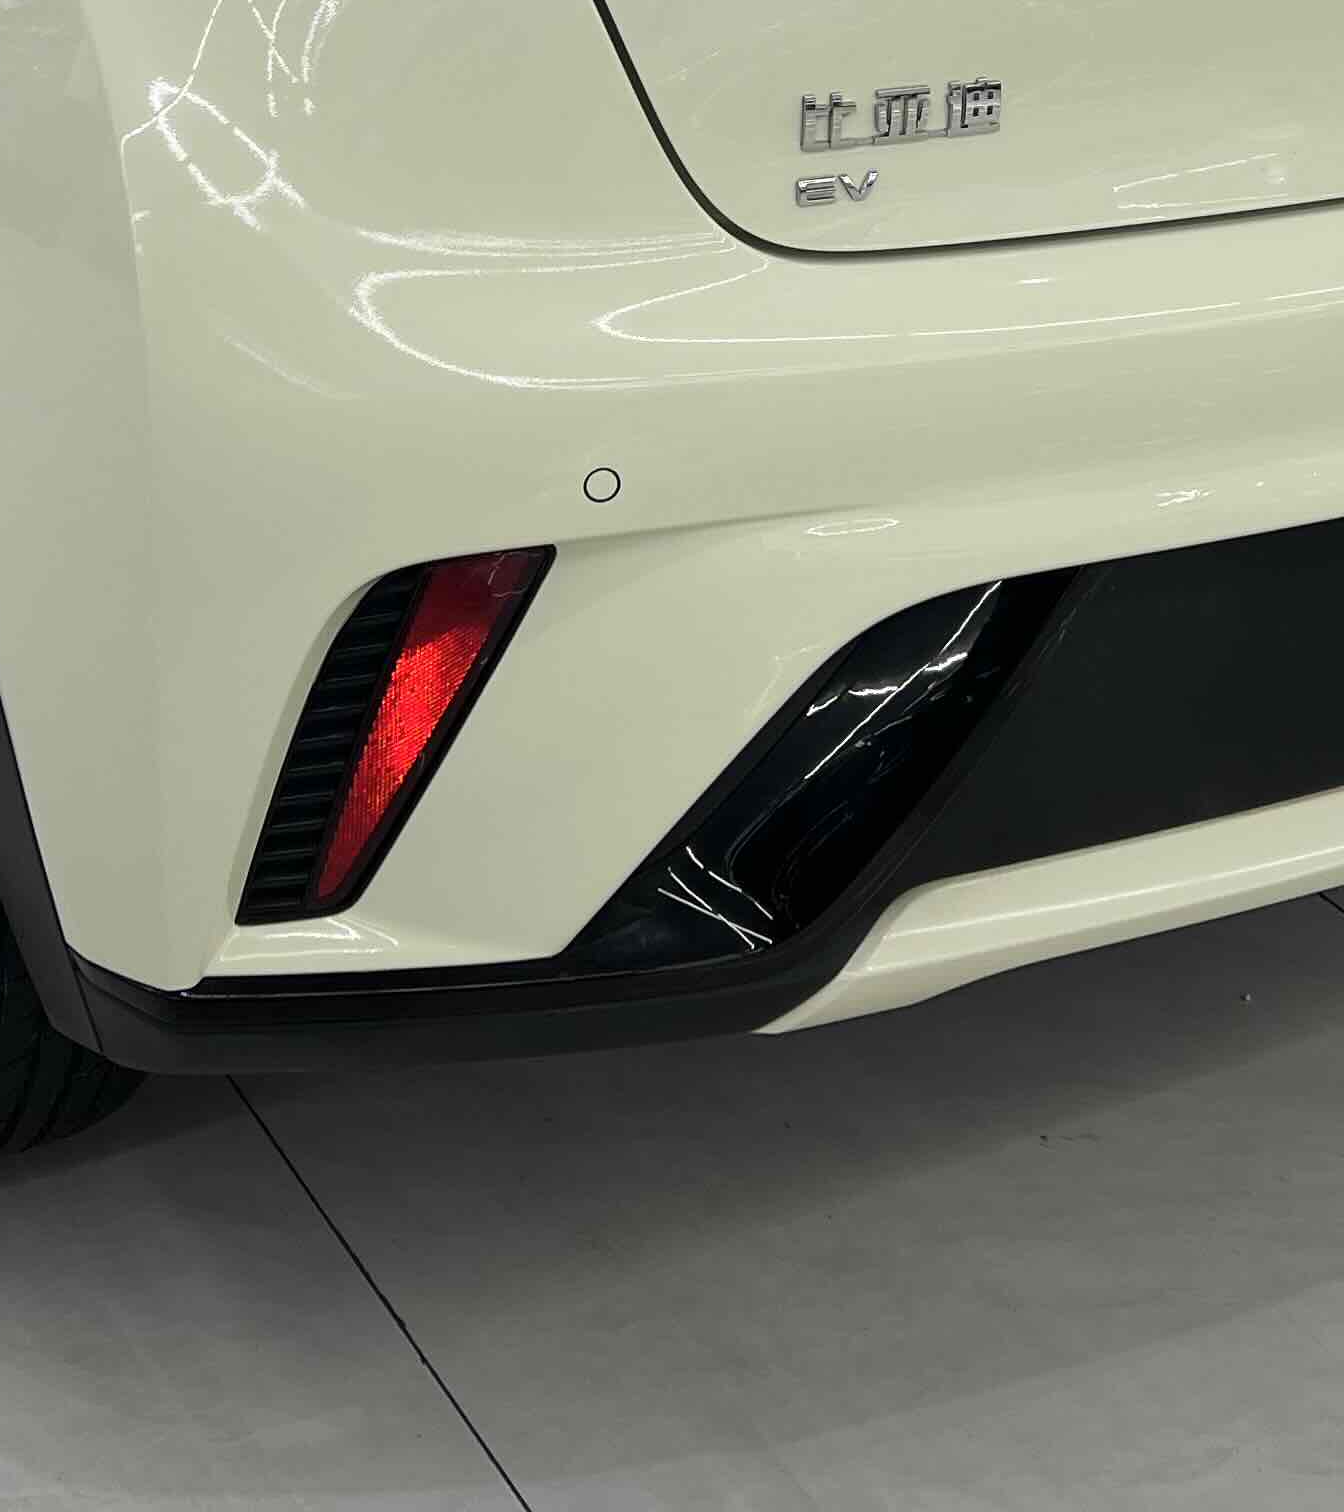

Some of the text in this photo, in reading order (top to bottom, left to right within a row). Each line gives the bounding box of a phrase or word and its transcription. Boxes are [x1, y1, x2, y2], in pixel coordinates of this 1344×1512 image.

[800, 76, 1002, 153] 比亚迪
[795, 168, 879, 207] EV
